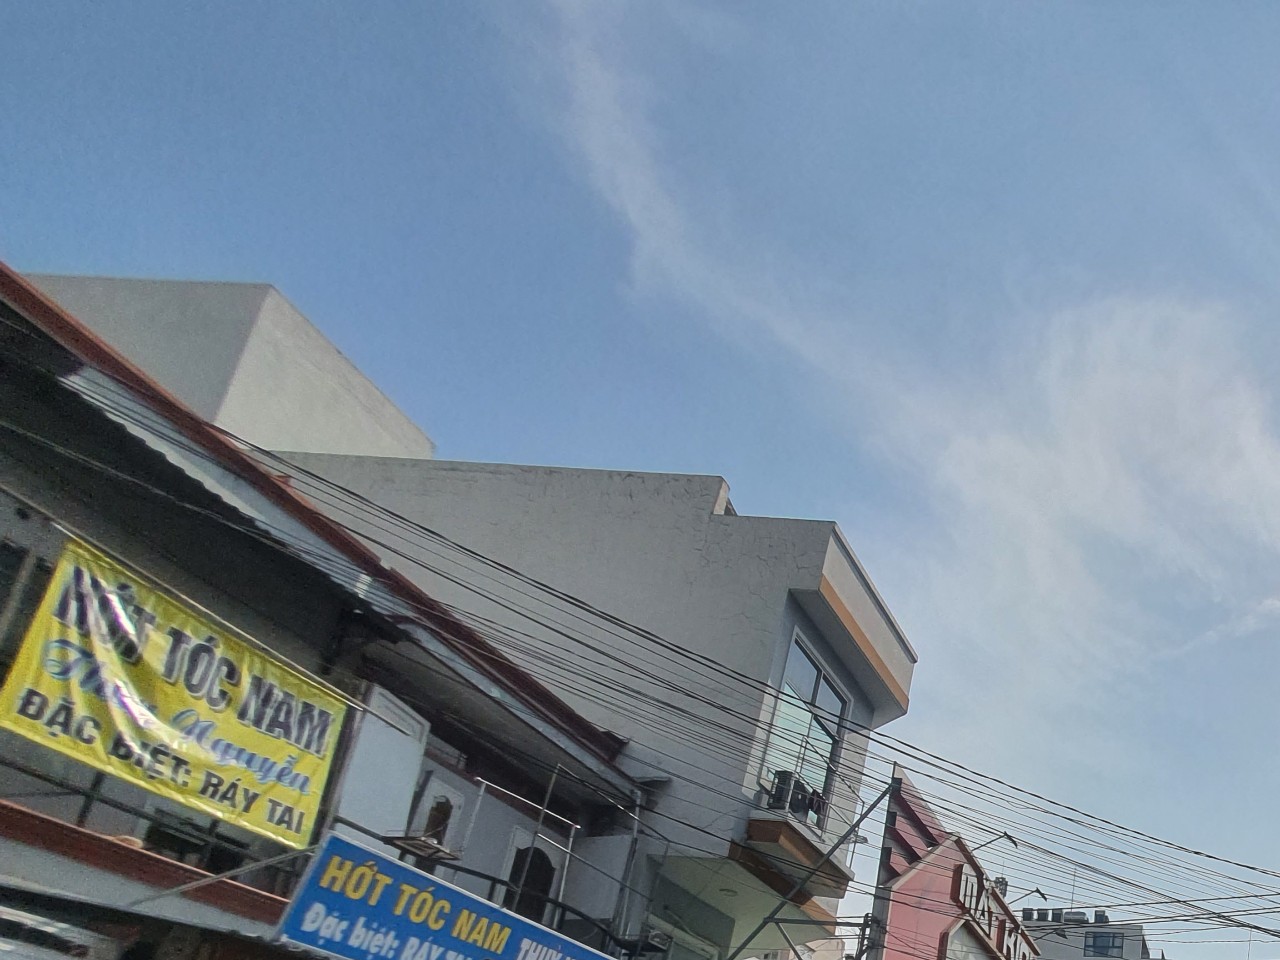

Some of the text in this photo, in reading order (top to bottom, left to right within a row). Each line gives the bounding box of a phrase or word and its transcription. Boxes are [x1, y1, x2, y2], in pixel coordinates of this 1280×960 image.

[161, 626, 241, 712] TÓC
[237, 674, 334, 759] NAM
[199, 769, 260, 814] RÁY
[267, 798, 305, 835] TAI
[301, 902, 348, 945] Đặc
[319, 855, 511, 954] HỚT TÓC NAM
